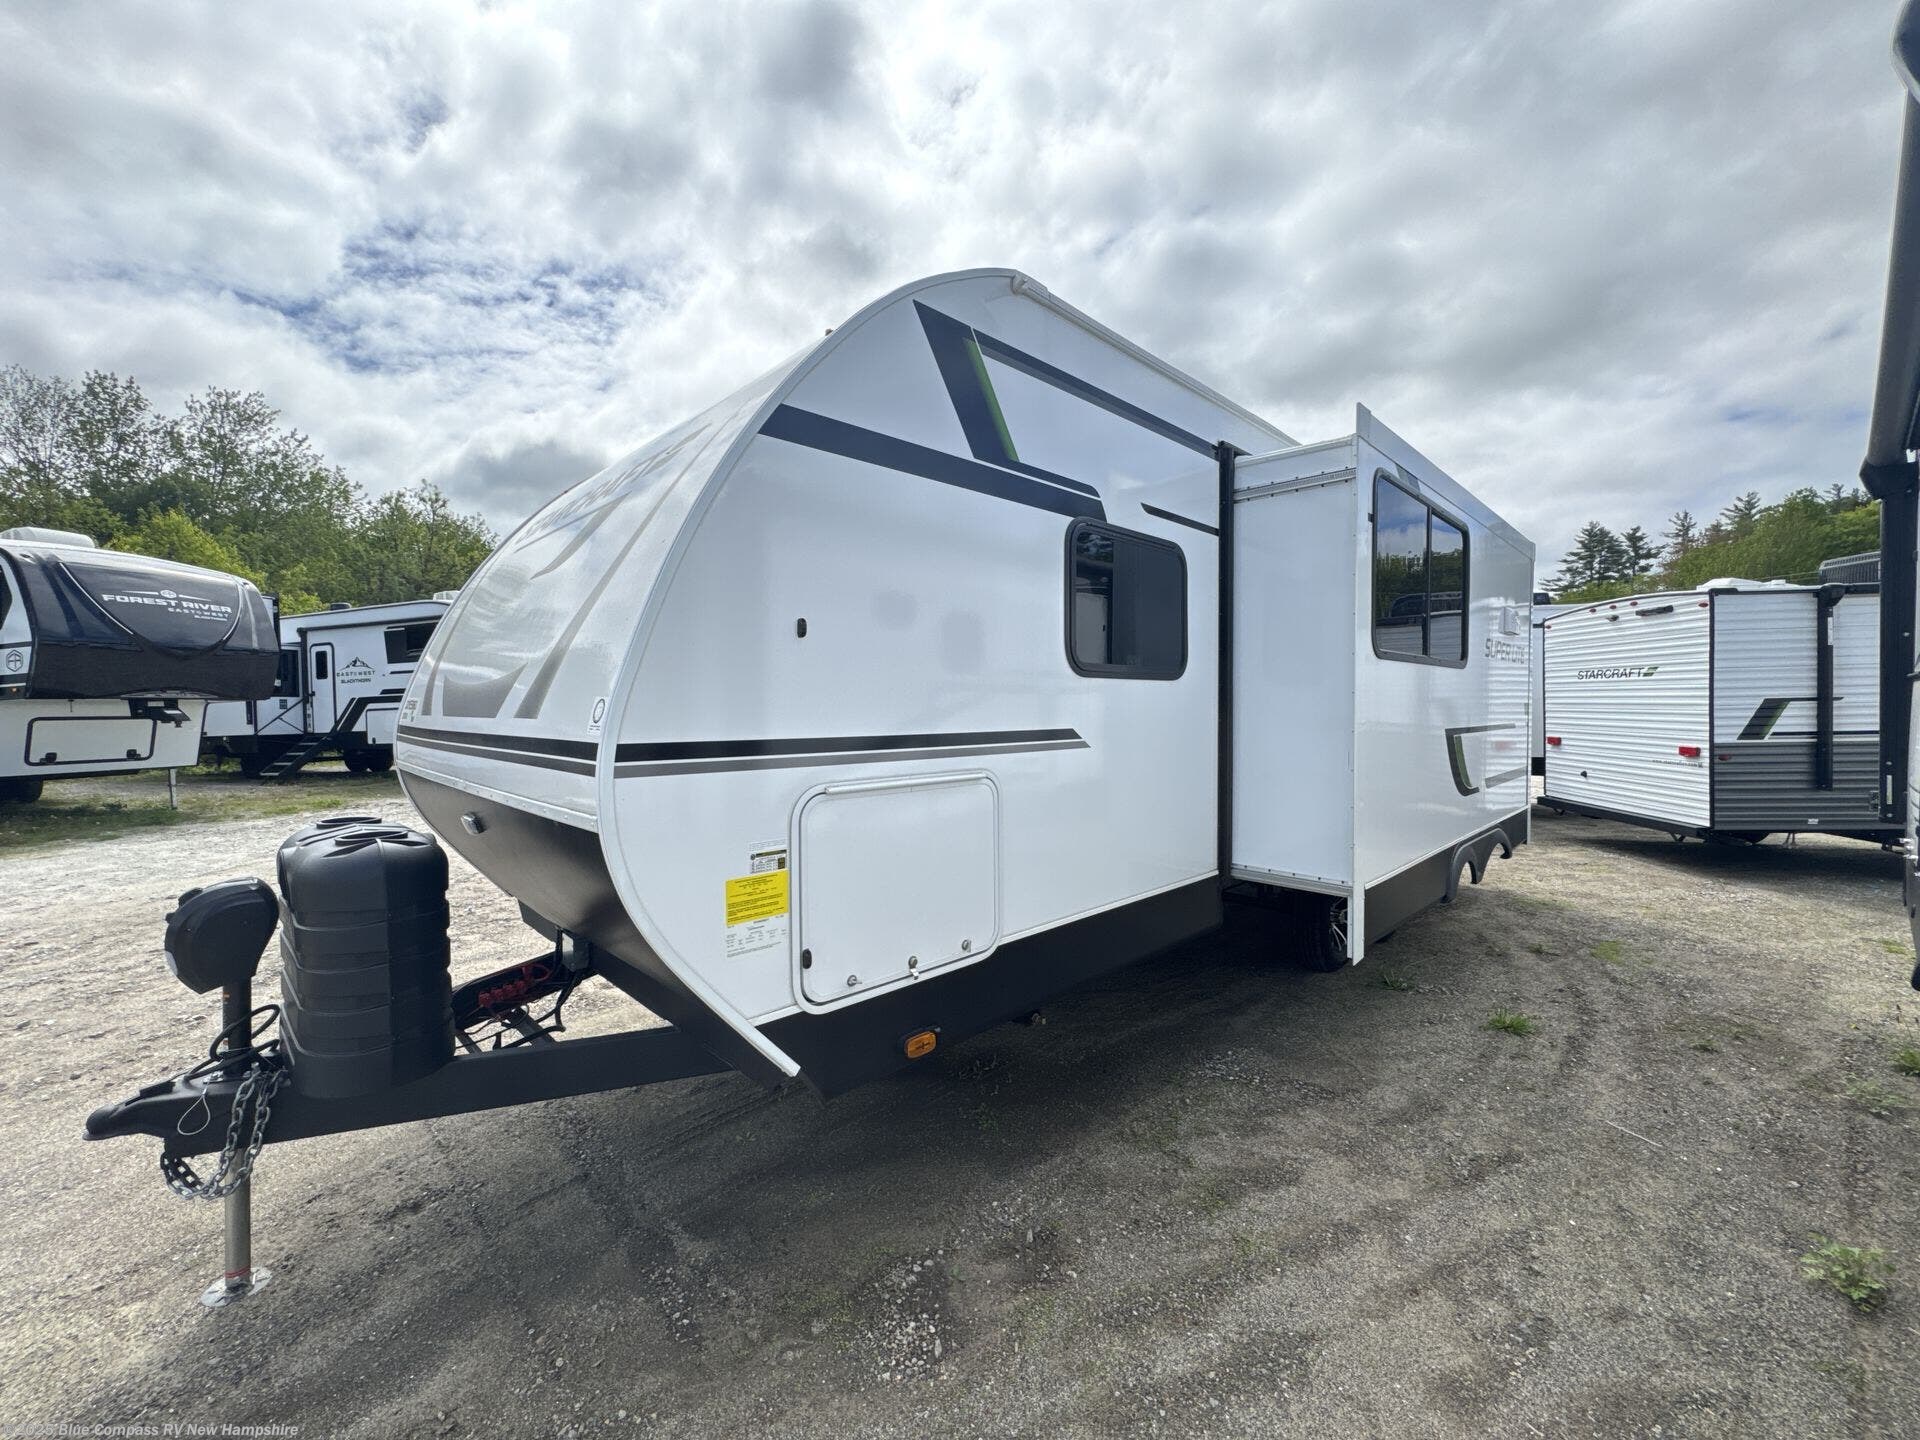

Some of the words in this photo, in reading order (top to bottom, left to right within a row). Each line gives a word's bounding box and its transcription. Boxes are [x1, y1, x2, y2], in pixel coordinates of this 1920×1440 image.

[102, 594, 178, 606] FOREST
[181, 601, 232, 613] RIVER
[1577, 667, 1645, 680] STARCRAFT
